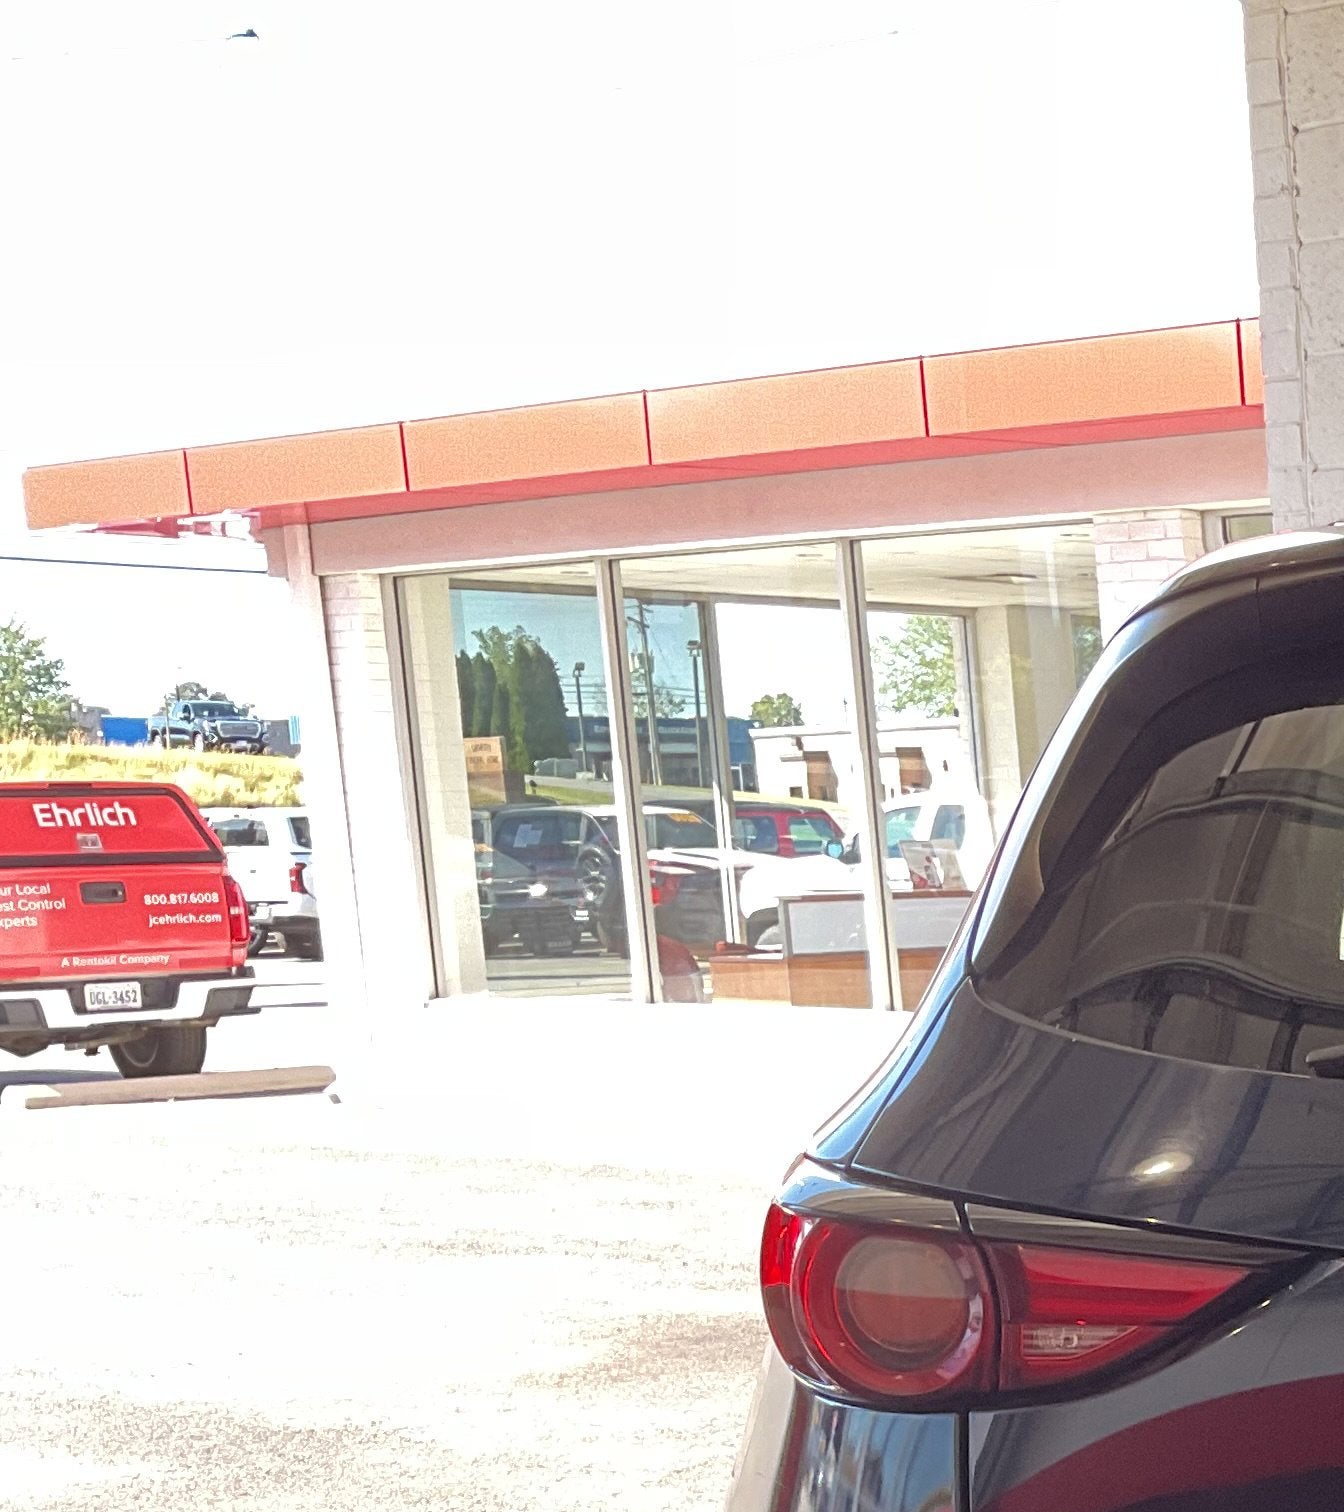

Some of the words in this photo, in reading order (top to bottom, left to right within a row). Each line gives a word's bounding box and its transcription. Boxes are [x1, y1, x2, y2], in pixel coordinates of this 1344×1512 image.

[32, 801, 137, 828] Ehrlich
[15, 882, 51, 896] Local
[17, 898, 66, 911] Control
[149, 914, 222, 928] jcehrlich.com
[61, 957, 70, 968] A
[119, 953, 170, 966] Company
